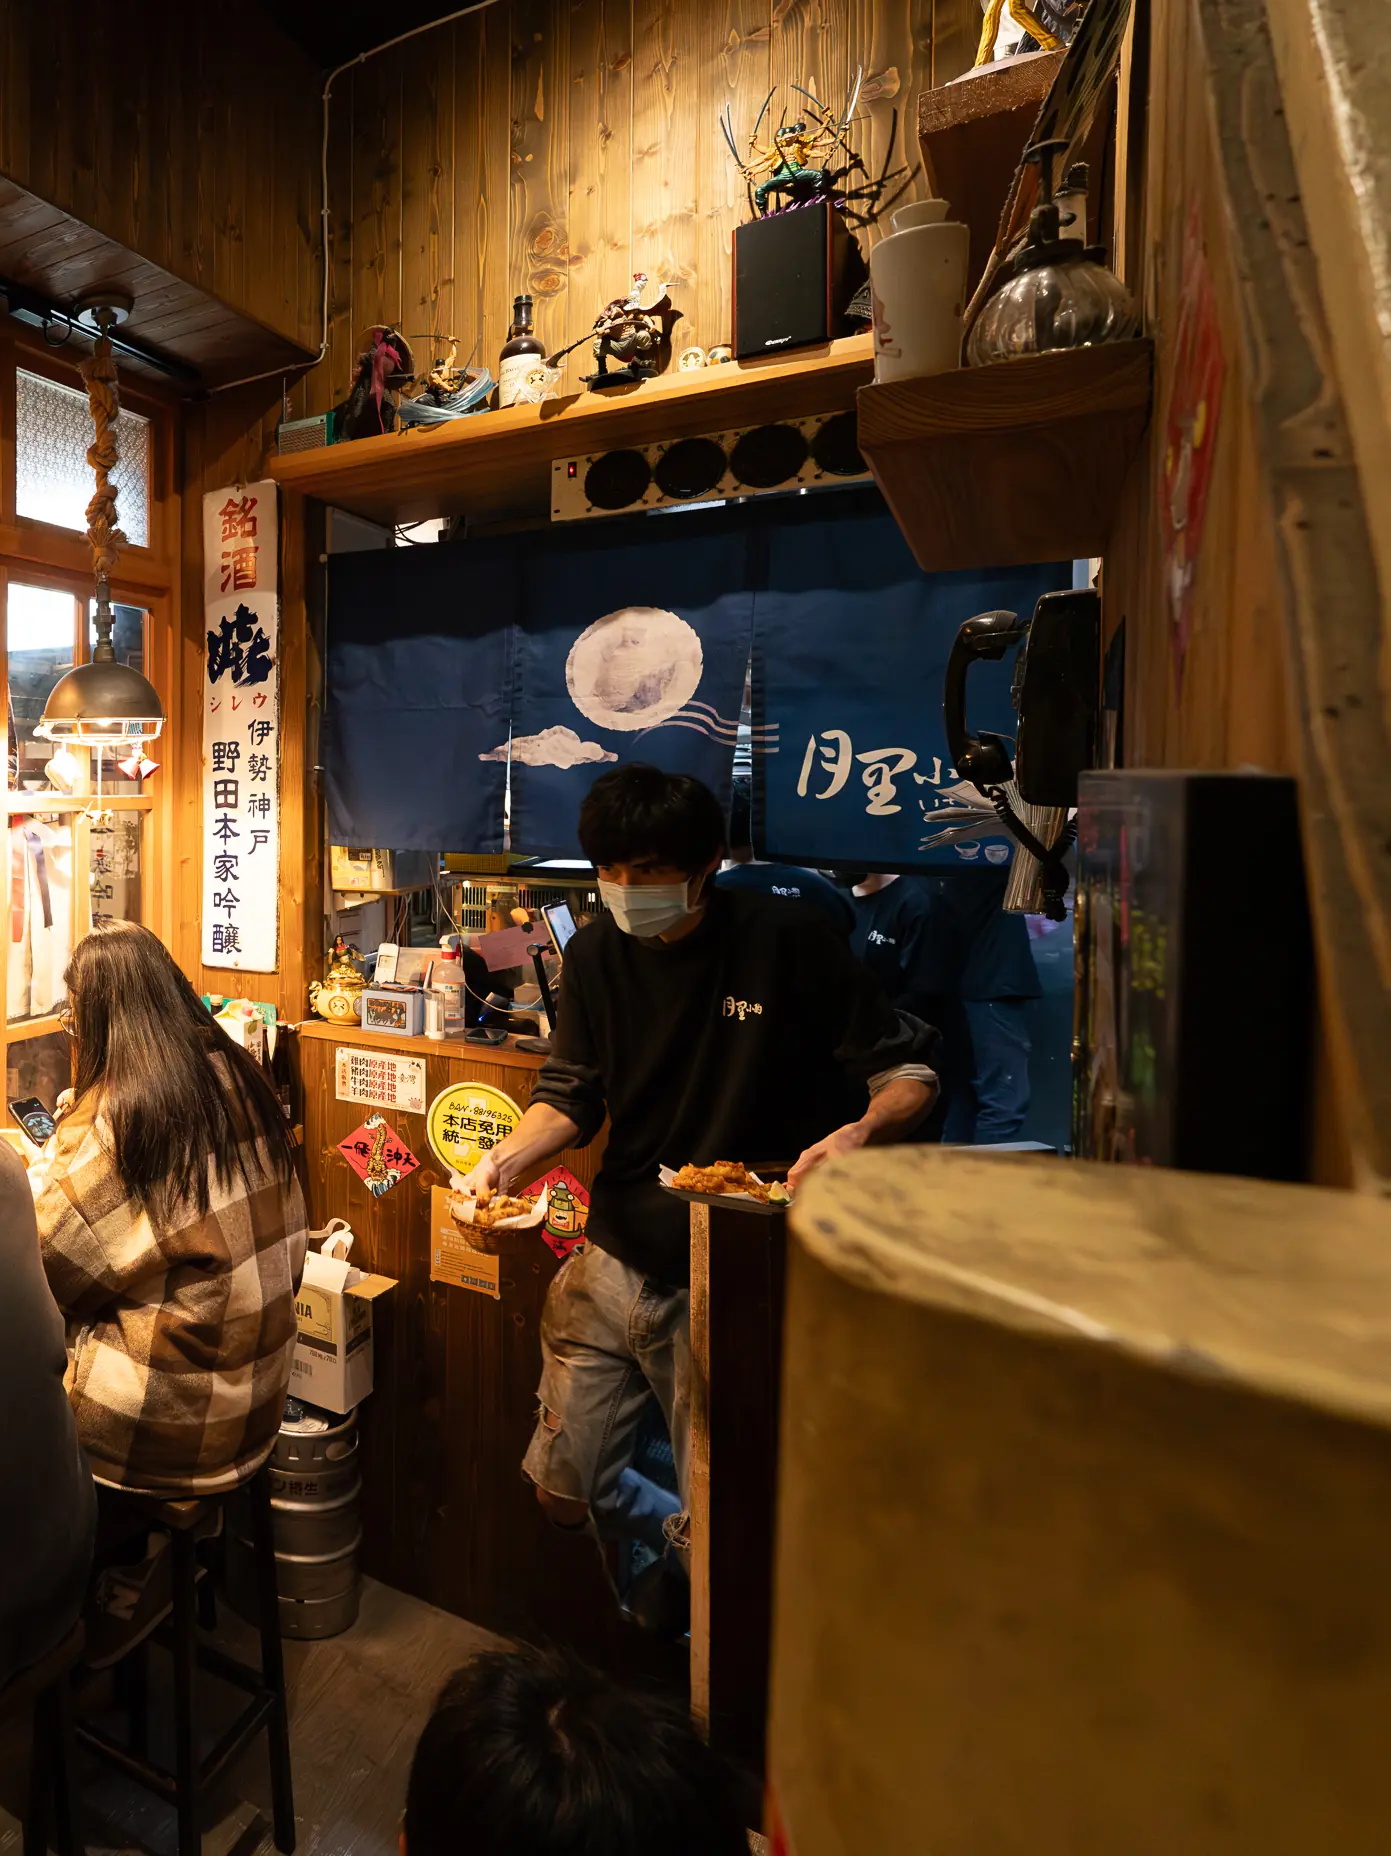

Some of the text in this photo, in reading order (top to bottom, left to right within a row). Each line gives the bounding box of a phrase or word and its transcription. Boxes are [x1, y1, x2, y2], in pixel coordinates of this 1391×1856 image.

[218, 495, 260, 593] 銘酒
[442, 1113, 513, 1137] 本店免用
[442, 1128, 504, 1150] 統一發
